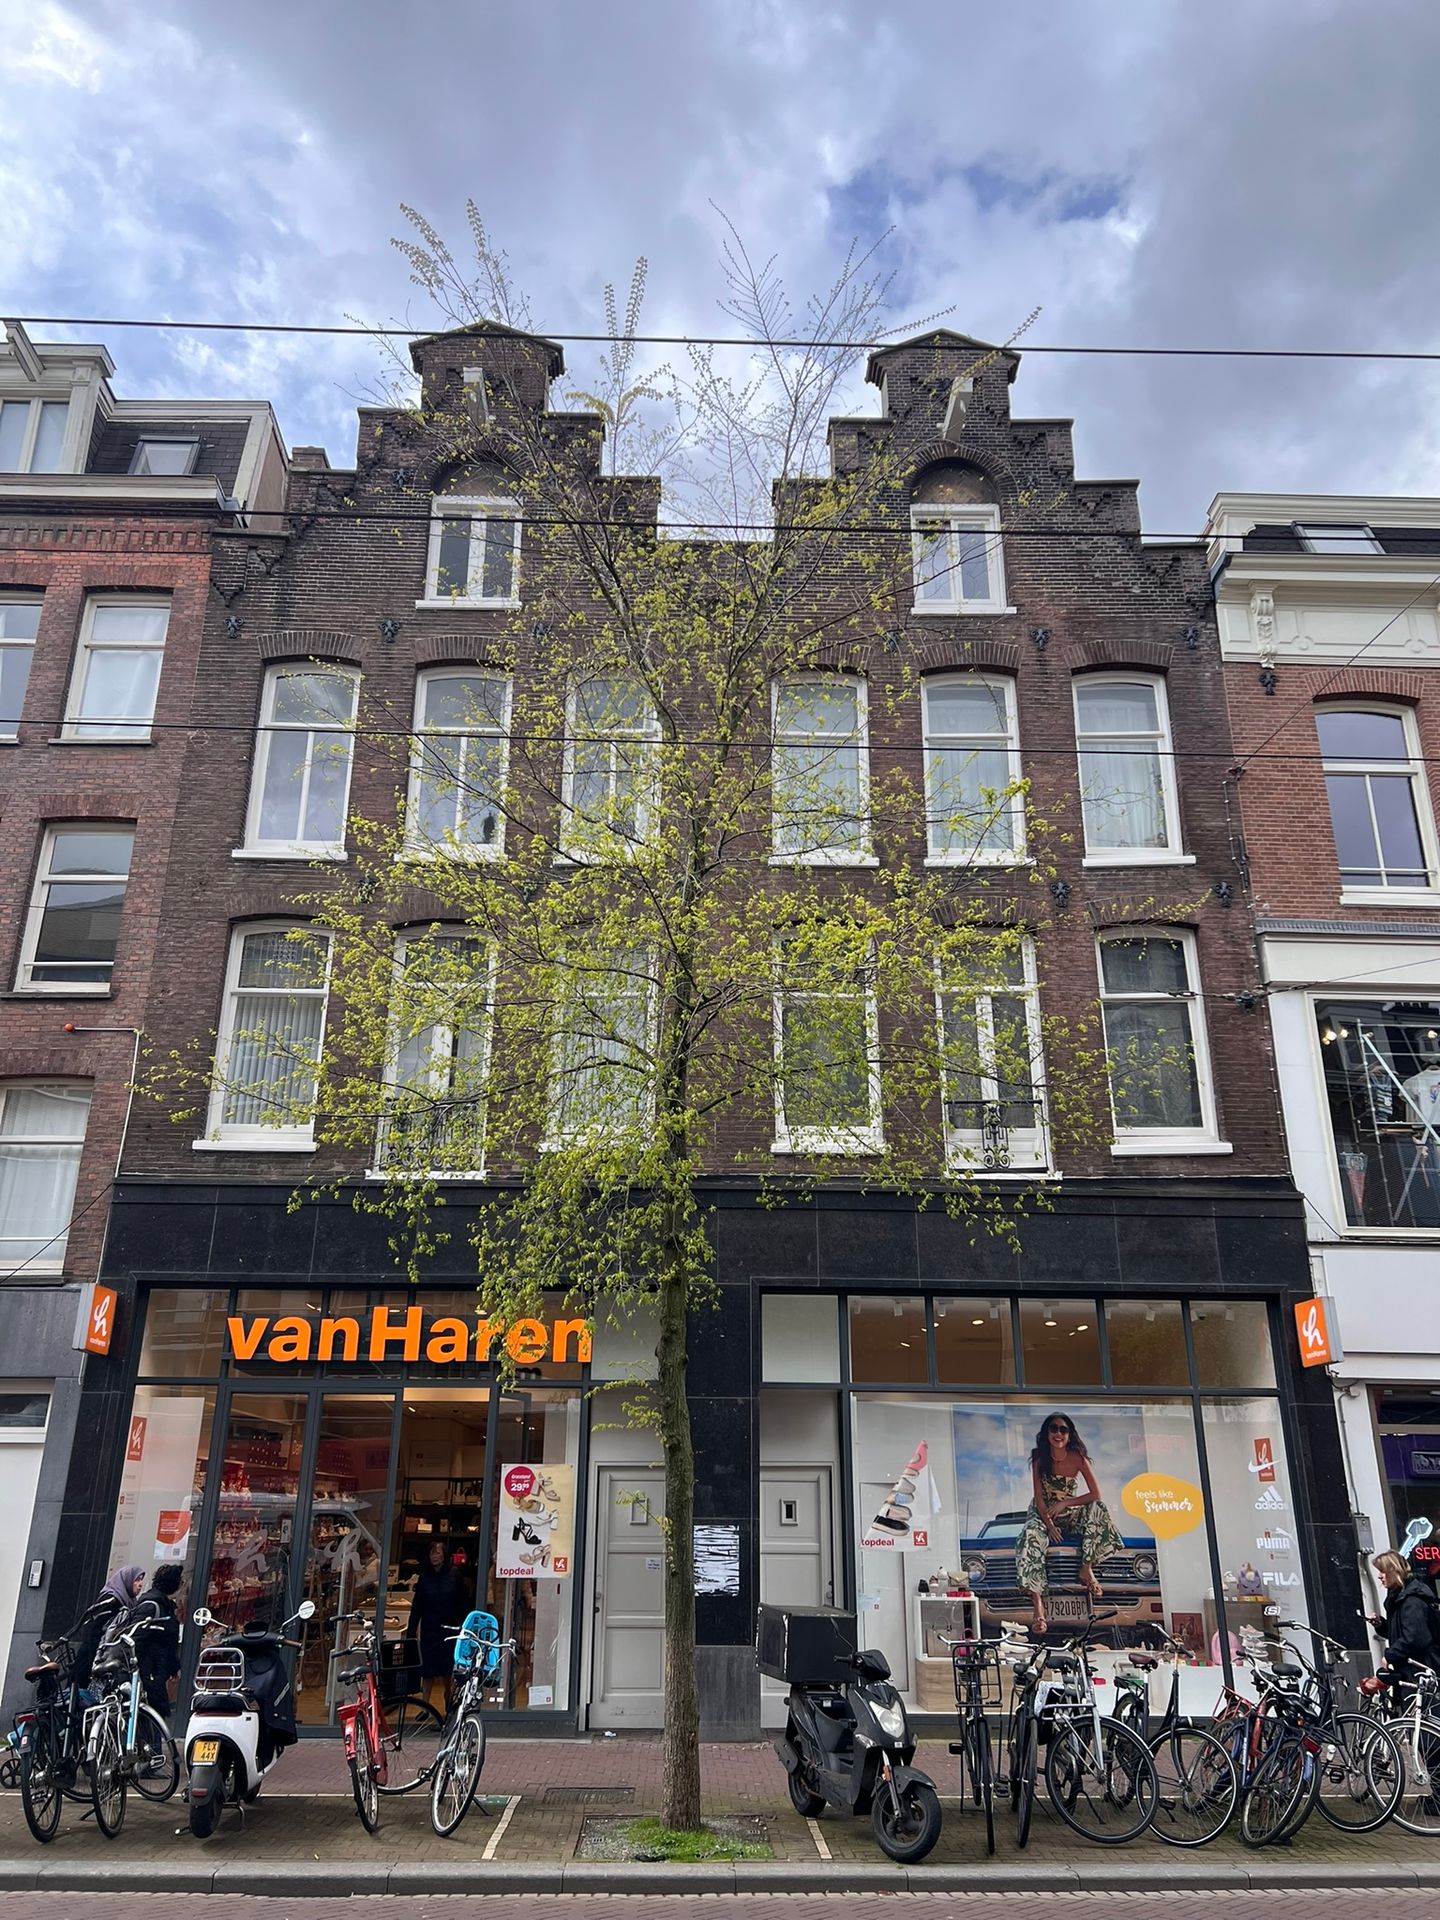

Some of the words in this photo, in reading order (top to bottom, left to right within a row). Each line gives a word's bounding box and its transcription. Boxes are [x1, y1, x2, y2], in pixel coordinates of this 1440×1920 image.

[226, 1306, 592, 1364] vanHaren
[1135, 1489, 1158, 1500] feels
[1158, 1489, 1174, 1499] like
[1143, 1497, 1194, 1513] Summer
[861, 1538, 894, 1547] topdeal
[1256, 1537, 1291, 1549] PUMA
[500, 1567, 533, 1576] topdeal
[1262, 1571, 1301, 1586] FILA
[202, 1742, 216, 1750] FLX
